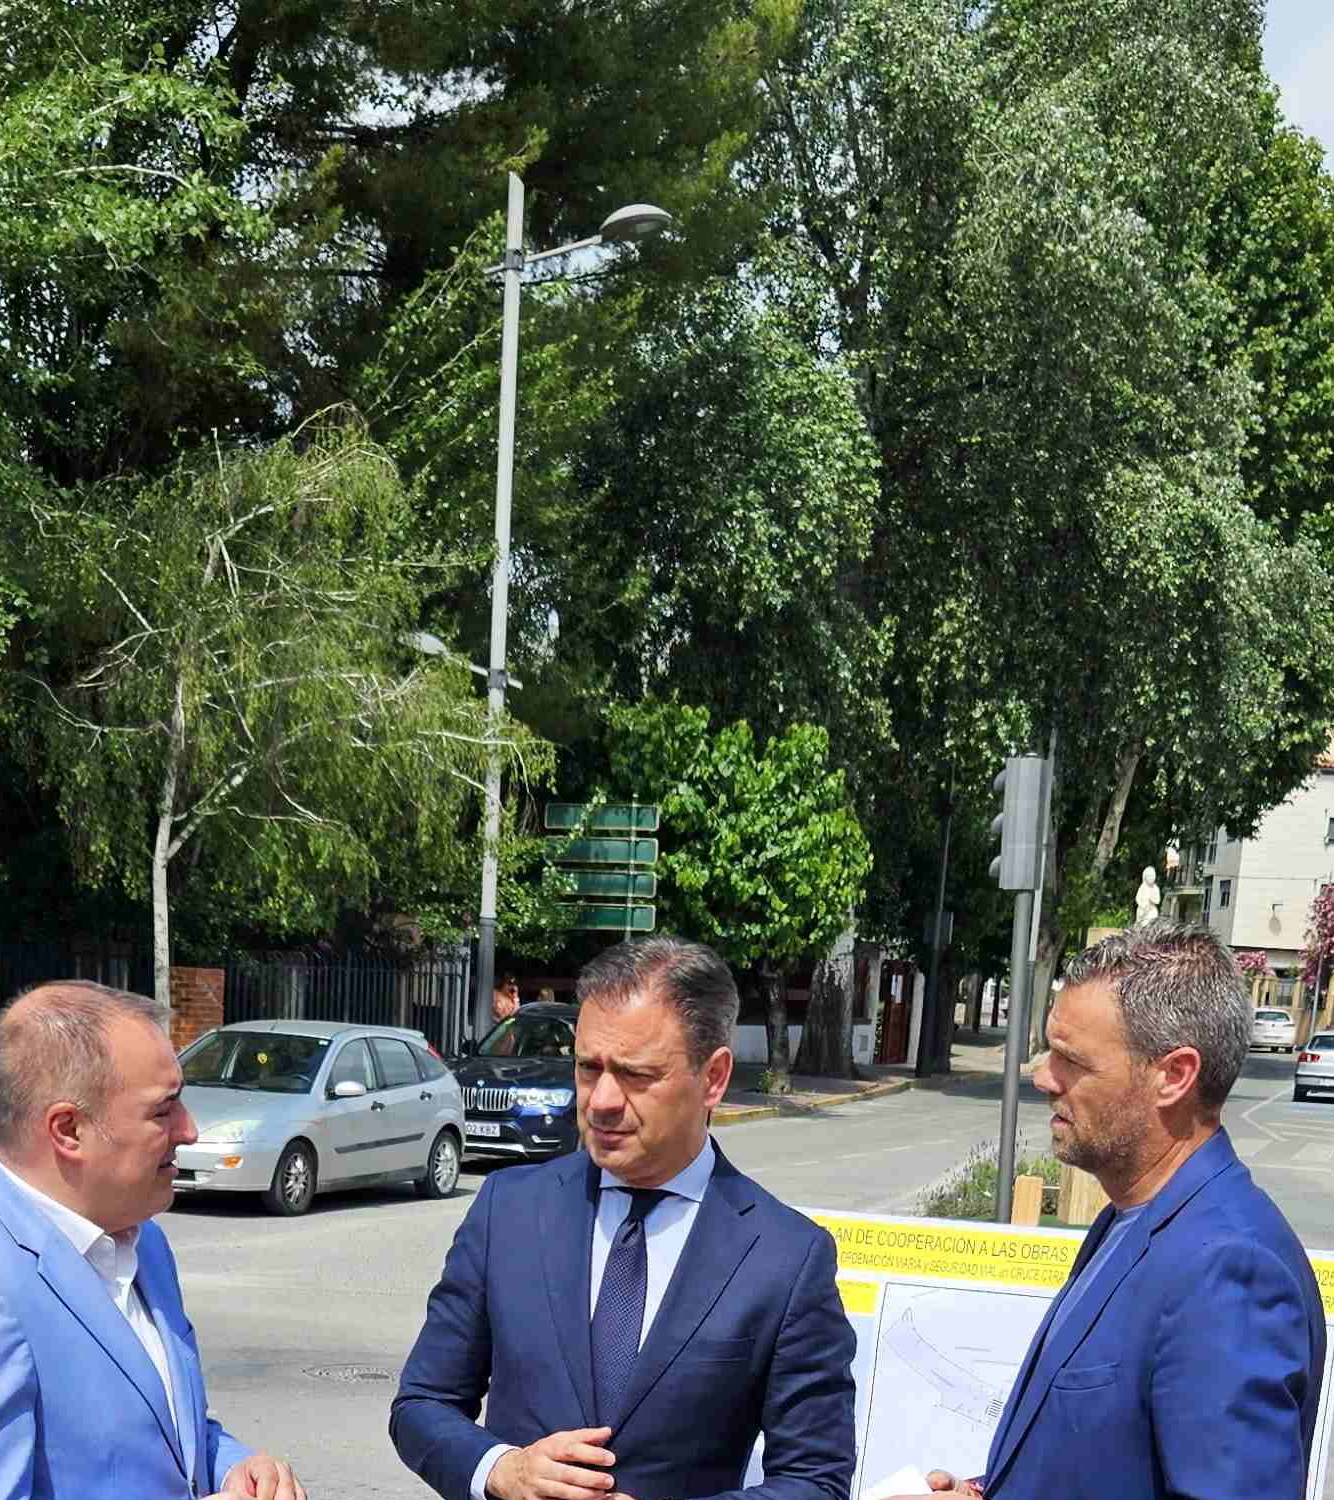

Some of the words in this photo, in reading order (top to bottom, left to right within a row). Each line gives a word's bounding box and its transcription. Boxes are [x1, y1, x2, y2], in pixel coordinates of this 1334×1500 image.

[835, 1227, 852, 1243] AN
[855, 1229, 874, 1245] DE
[877, 1230, 976, 1255] COOPERACIÓN
[978, 1240, 988, 1256] A
[991, 1241, 1018, 1258] LAS
[1021, 1243, 1069, 1263] OBRAS
